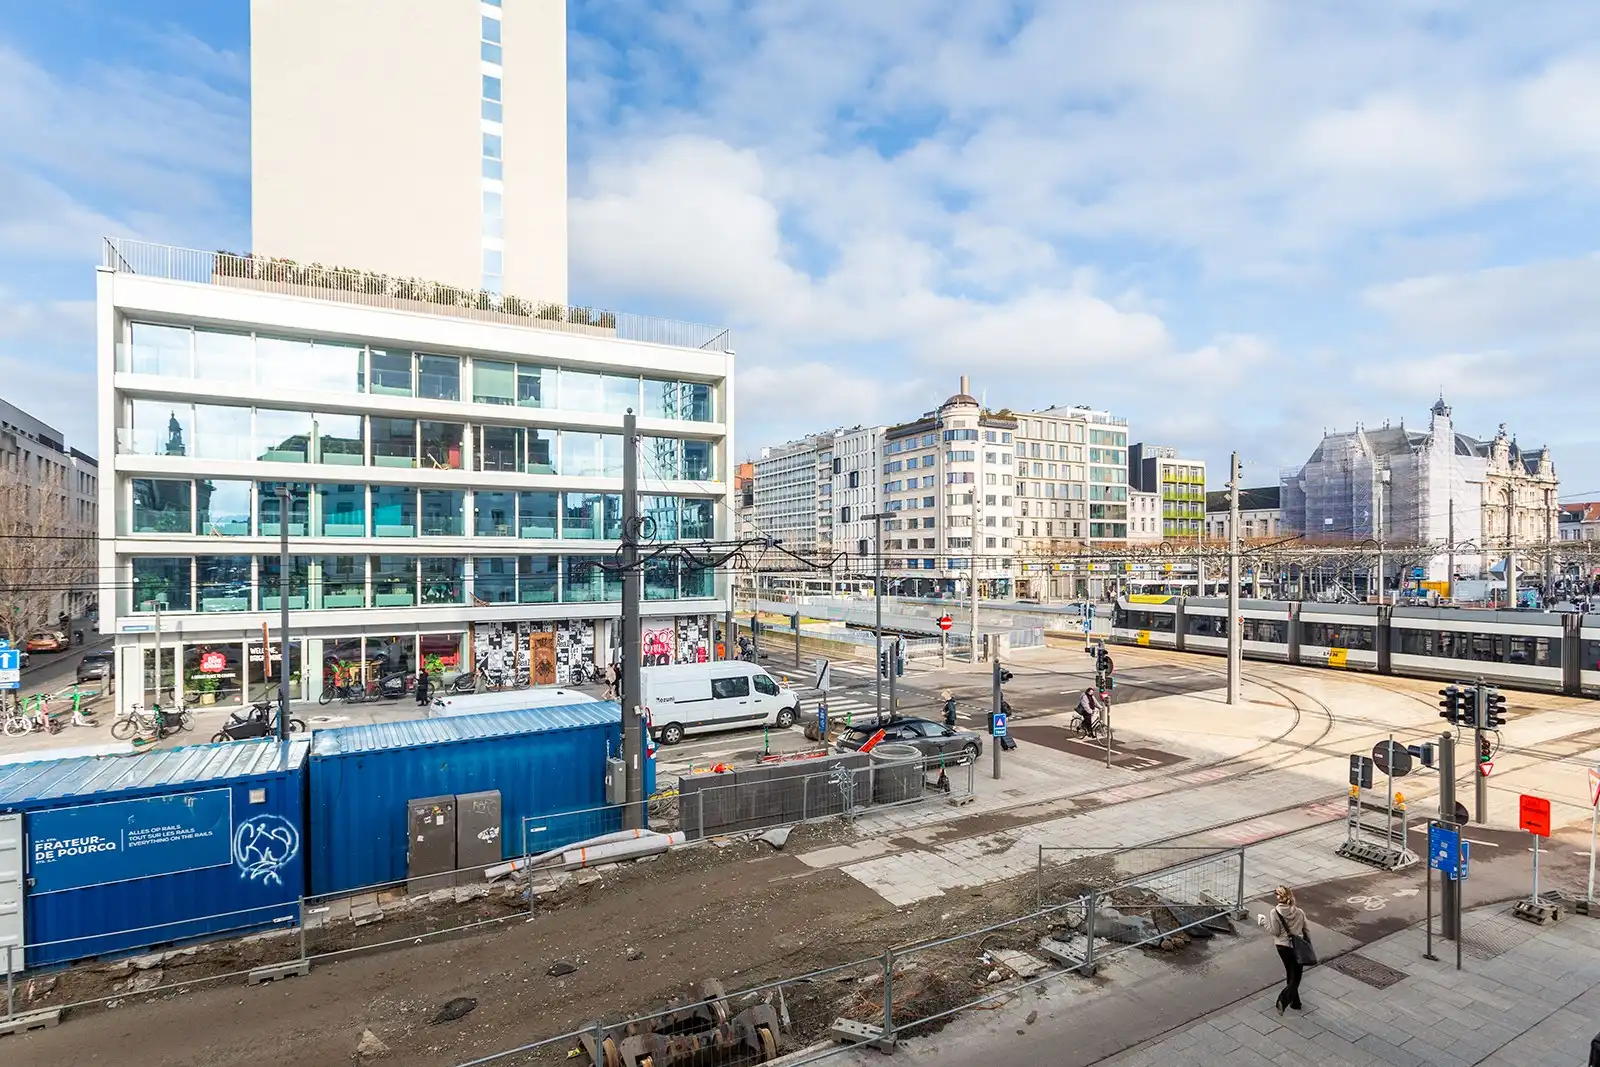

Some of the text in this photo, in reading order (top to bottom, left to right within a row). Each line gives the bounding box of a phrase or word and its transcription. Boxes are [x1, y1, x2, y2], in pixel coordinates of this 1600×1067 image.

[128, 828, 150, 836] ALLES
[35, 836, 105, 852] FRATEUR-
[128, 837, 169, 848] EVERYTHING
[35, 842, 116, 861] DE POURCQ
